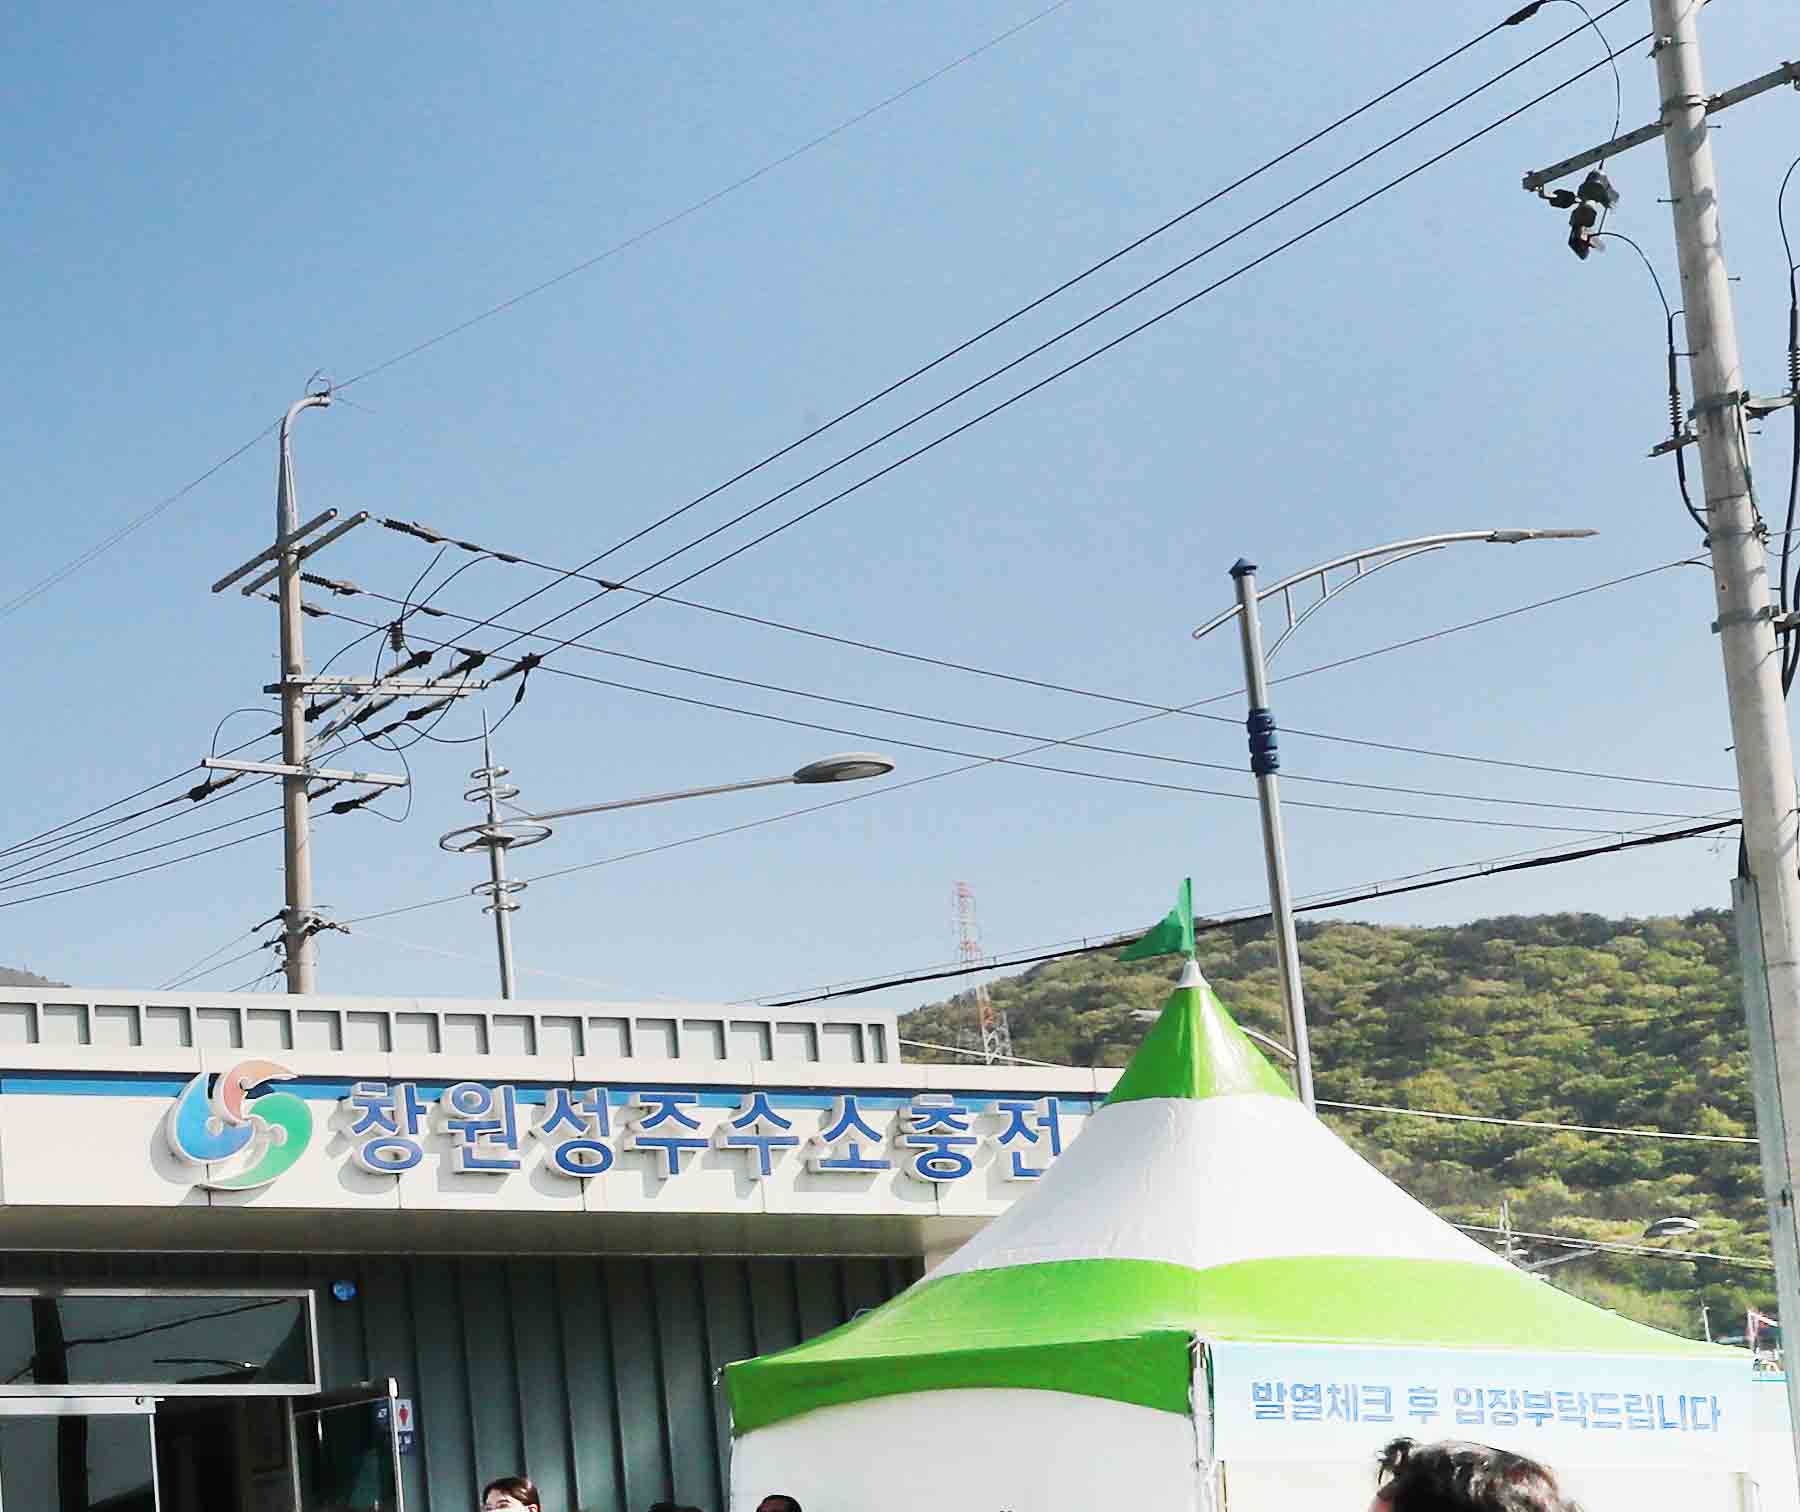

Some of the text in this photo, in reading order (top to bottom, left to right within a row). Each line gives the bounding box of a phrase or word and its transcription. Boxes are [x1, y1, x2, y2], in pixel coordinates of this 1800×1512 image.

[1250, 1380, 1723, 1434] 발열체크 후 입장부탁드립니다
